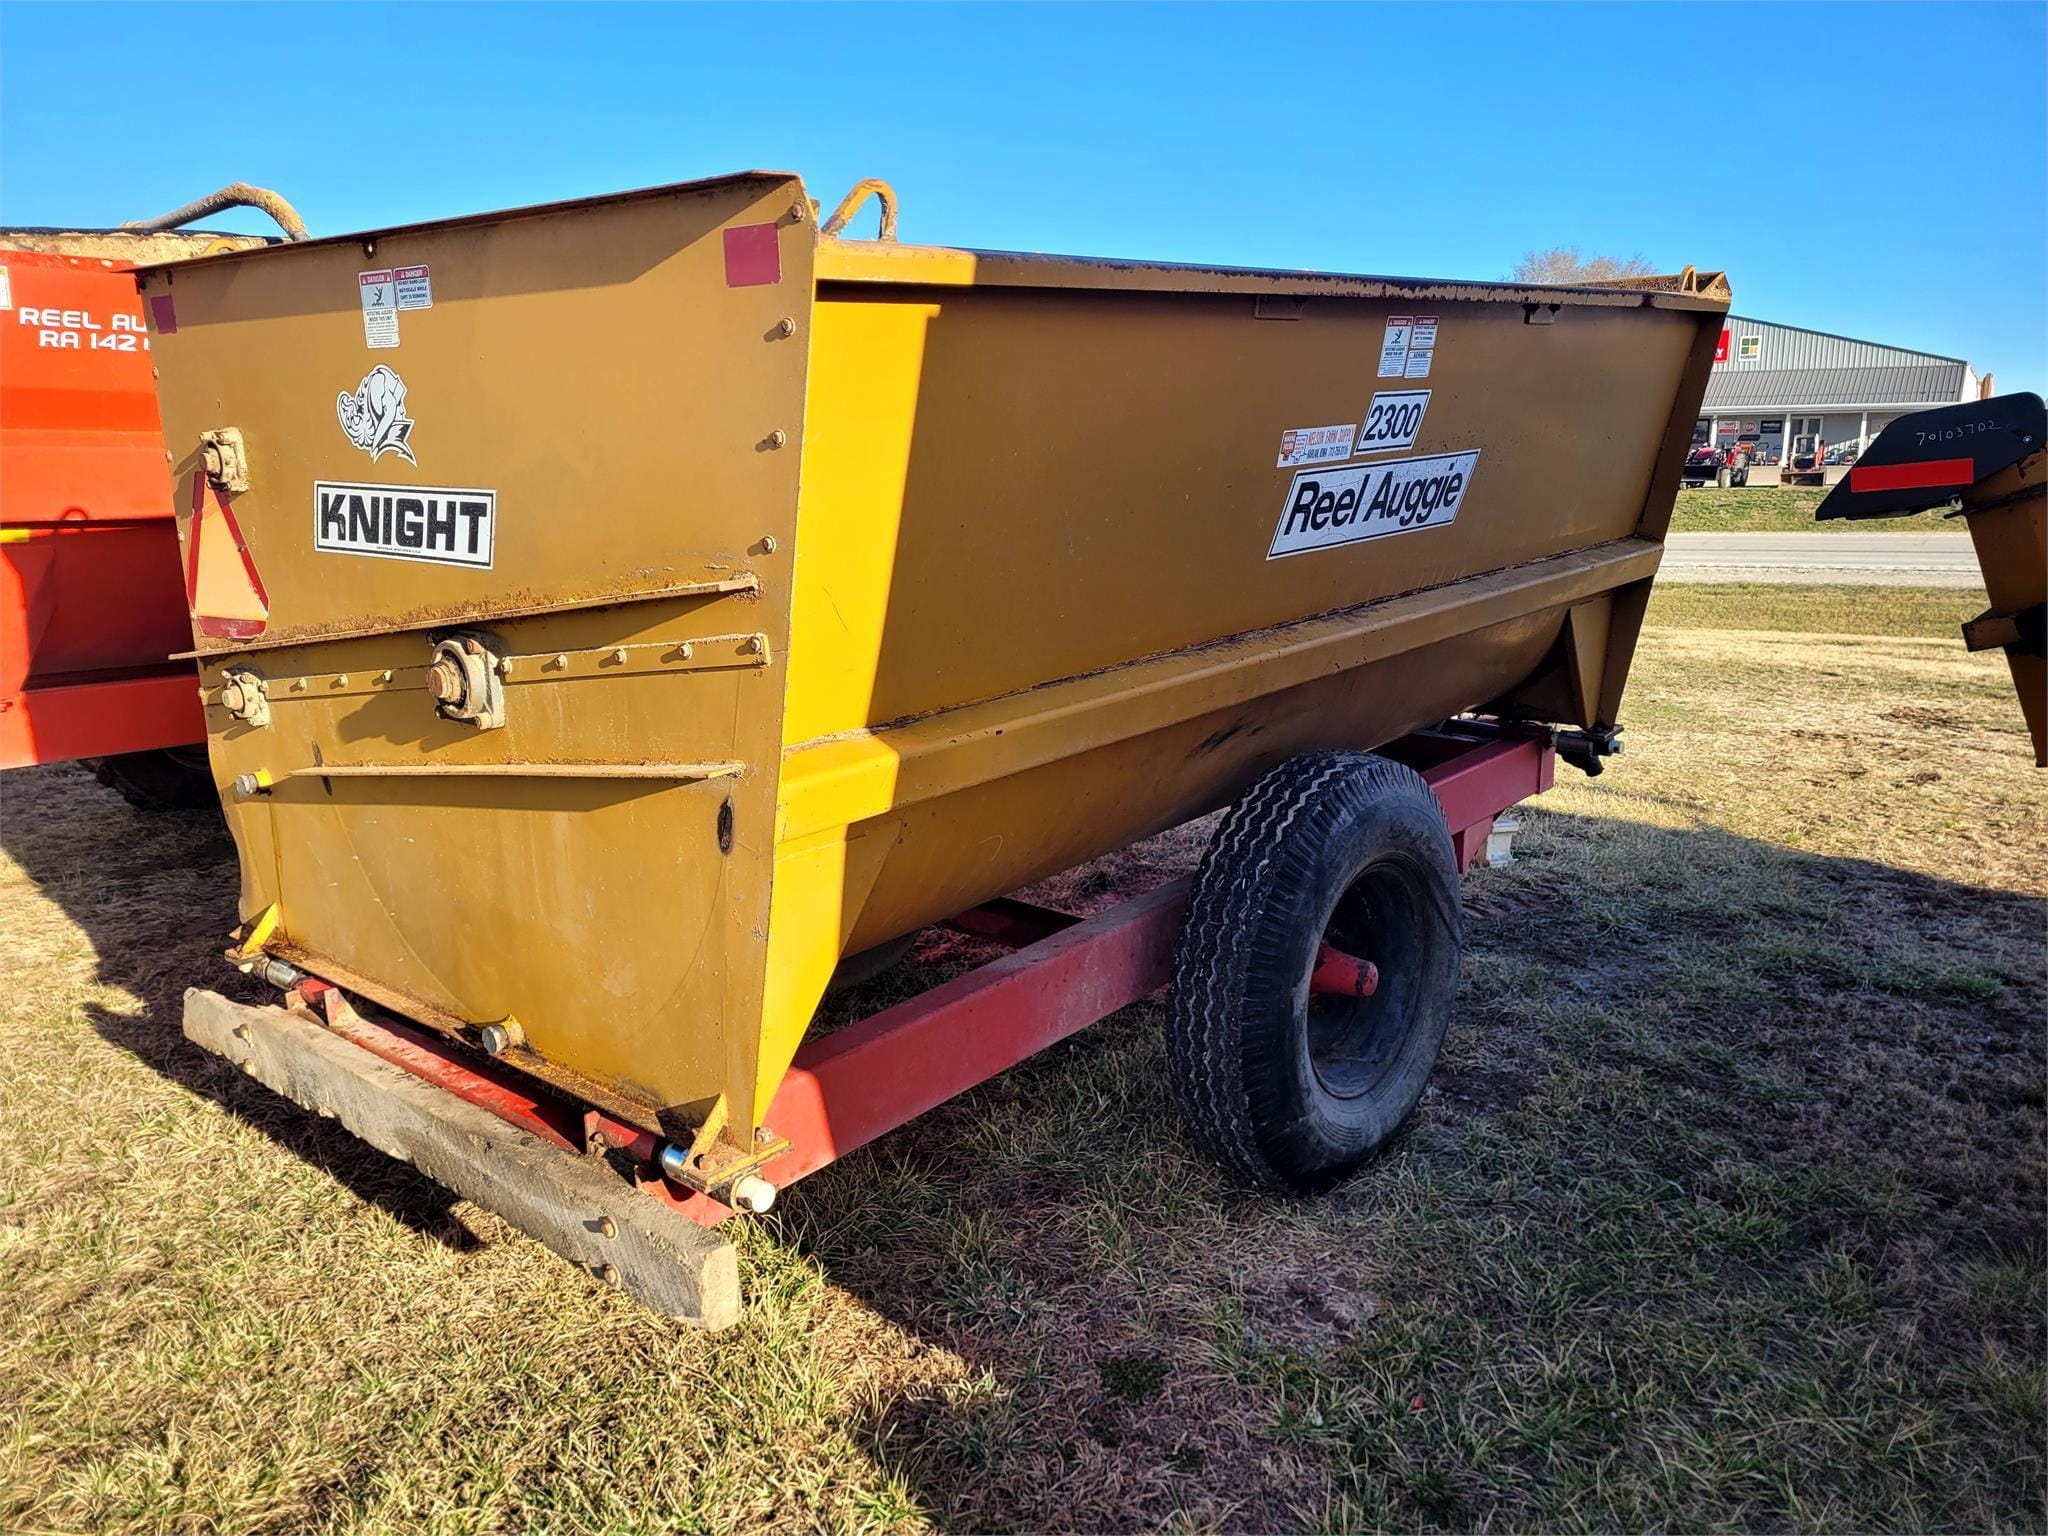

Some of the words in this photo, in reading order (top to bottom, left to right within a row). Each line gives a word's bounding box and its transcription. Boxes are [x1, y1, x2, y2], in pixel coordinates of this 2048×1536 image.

[366, 274, 385, 283] DANGER
[405, 269, 423, 278] DANGER
[20, 306, 102, 329] REEL
[40, 330, 79, 349] RA
[90, 333, 137, 352] 142
[1363, 403, 1422, 442] 2300
[1916, 419, 2002, 446] 70103702
[1283, 473, 1371, 536] Reel
[1362, 462, 1464, 527] Auggie
[321, 493, 488, 554] KNIGHT
